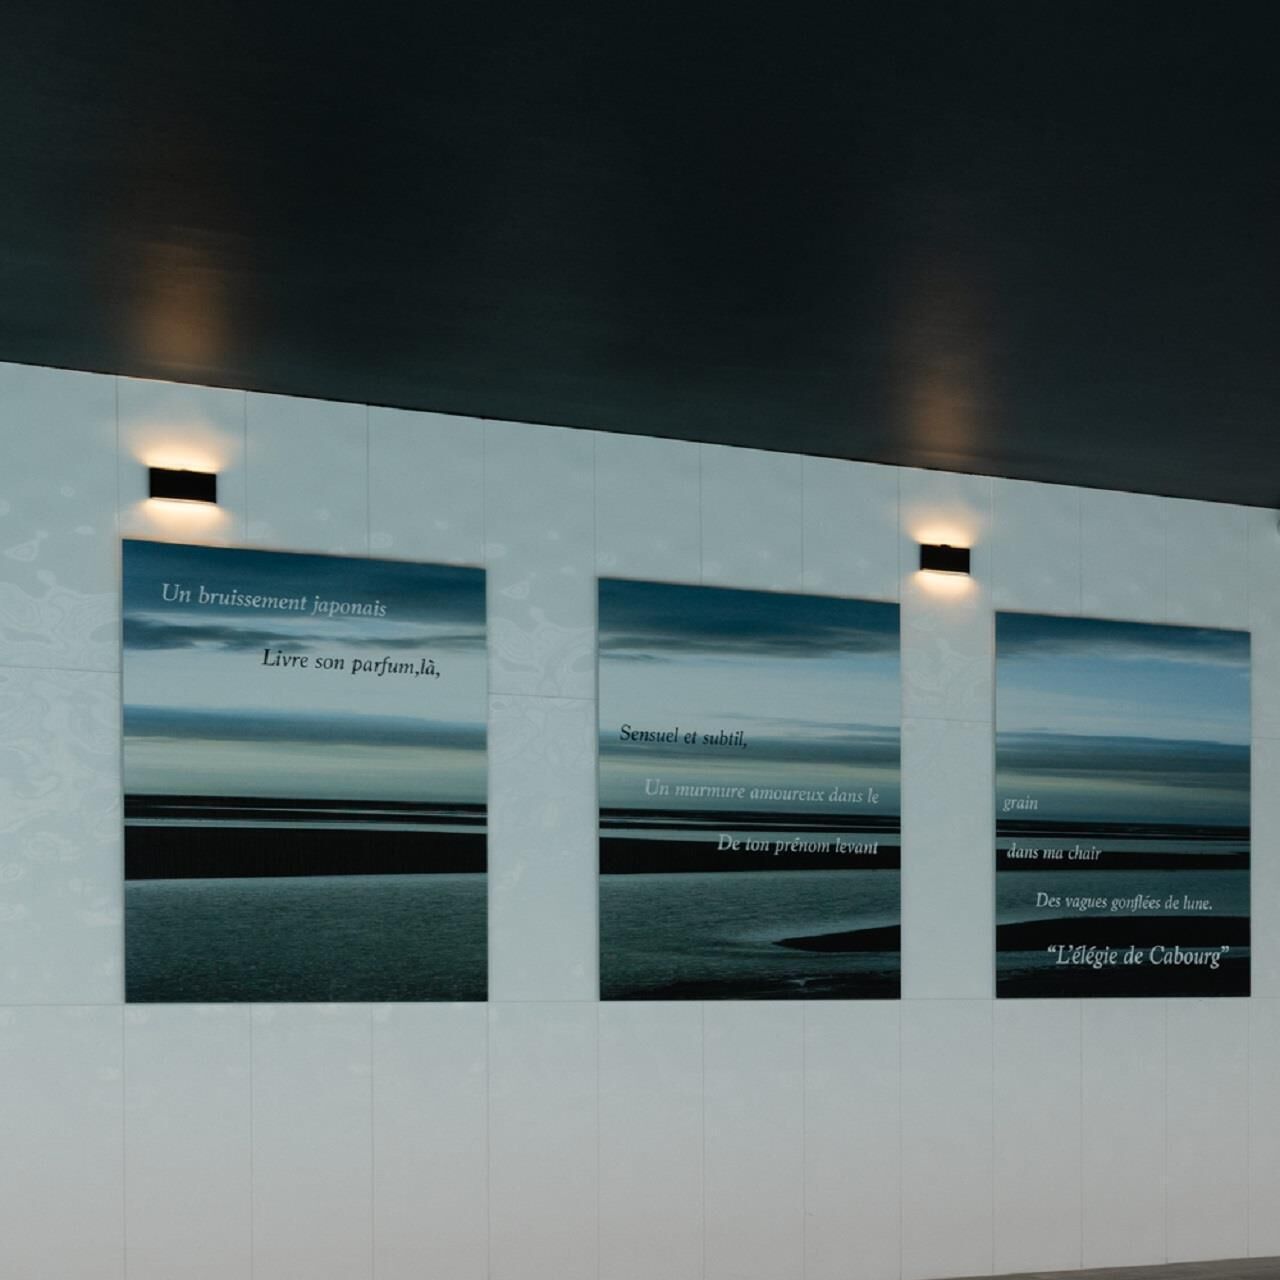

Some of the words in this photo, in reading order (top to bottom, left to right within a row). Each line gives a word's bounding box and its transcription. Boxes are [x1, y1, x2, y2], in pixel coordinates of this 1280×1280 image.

[162, 583, 191, 603] Un
[198, 585, 307, 611] bruissement
[311, 595, 388, 618] japonais
[262, 648, 309, 669] Livre
[314, 655, 345, 671] son
[619, 724, 679, 744] Sensuel
[684, 730, 698, 745] et
[702, 730, 748, 749] subtil,
[645, 778, 669, 796] Un
[675, 784, 745, 799] murmure
[750, 787, 824, 802] amoureux
[828, 786, 863, 804] dans
[867, 787, 880, 804] le
[1002, 794, 1039, 812] grain
[717, 834, 741, 851] De
[745, 837, 770, 852] ton
[774, 836, 830, 856] prénom
[835, 837, 879, 855] levant
[1006, 842, 1039, 860] dans
[1043, 847, 1063, 860] ma
[1067, 844, 1102, 861] chair
[1036, 892, 1061, 908] Des
[1065, 895, 1107, 911] vagues
[1111, 894, 1161, 913] gonflées
[1164, 895, 1180, 910] de
[1183, 895, 1213, 910] lune.
[1123, 945, 1143, 965] de
